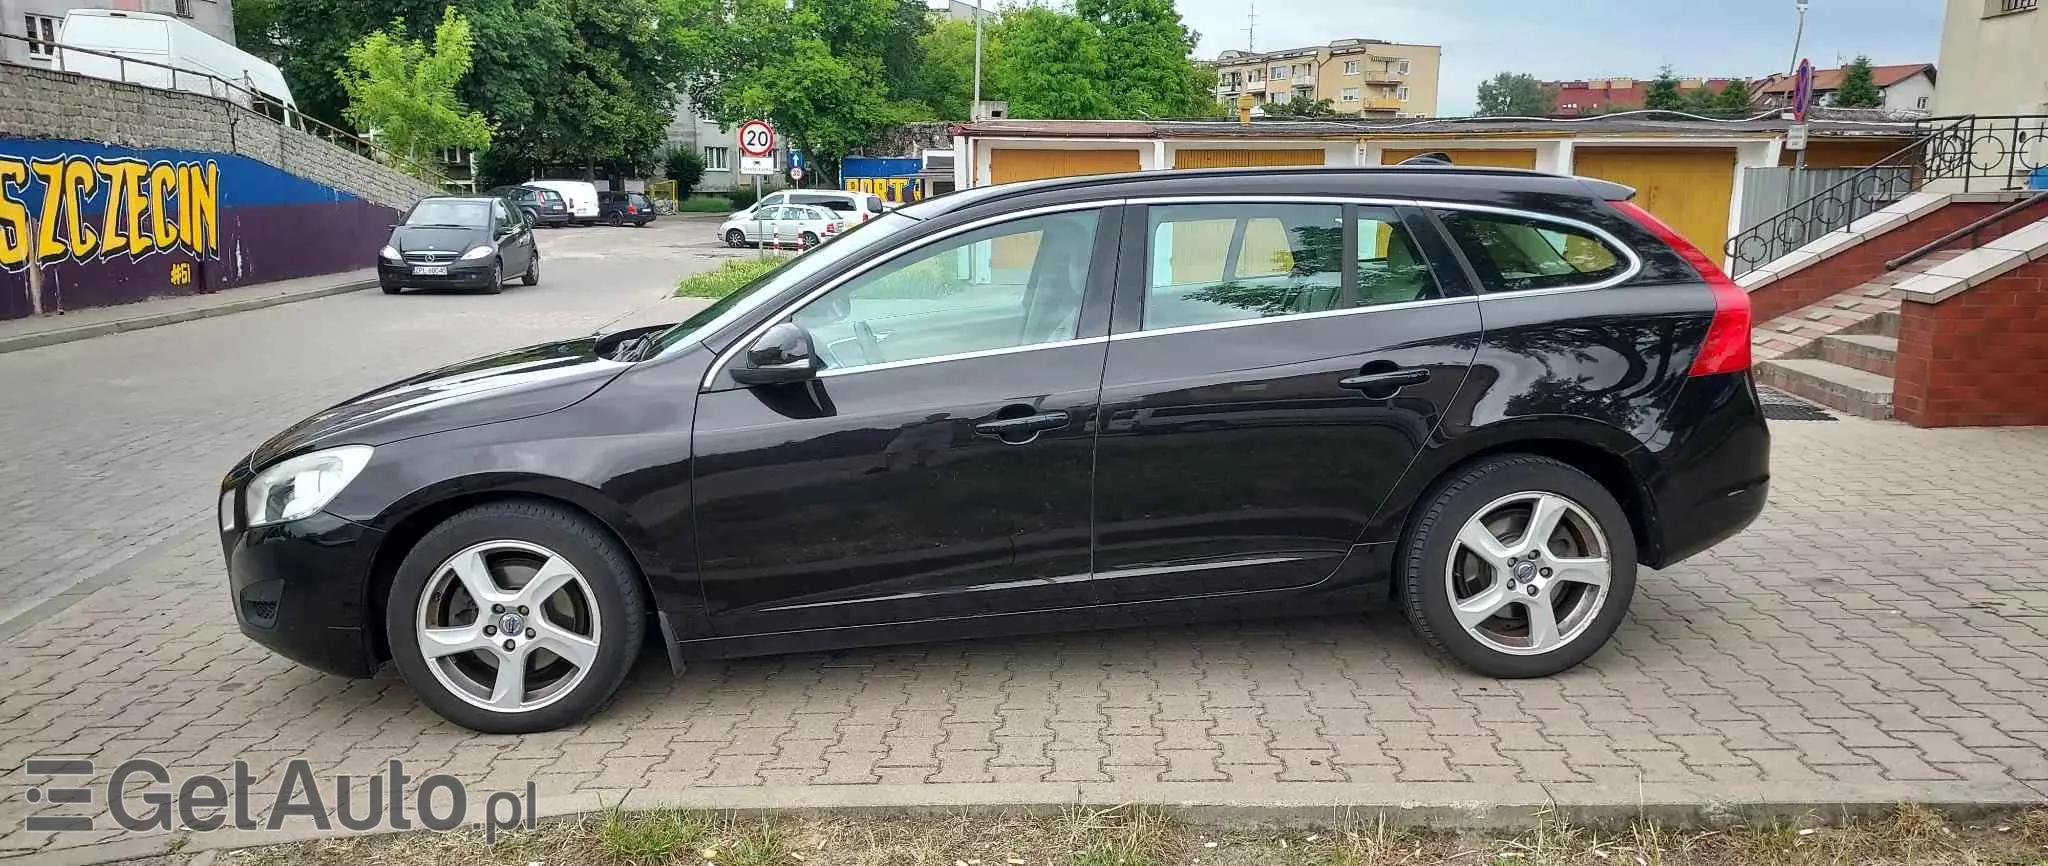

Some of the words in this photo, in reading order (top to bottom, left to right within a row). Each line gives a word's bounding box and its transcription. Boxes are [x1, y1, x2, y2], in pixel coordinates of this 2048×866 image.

[746, 130, 769, 147] 20
[0, 153, 220, 273] SZCZECIN
[170, 263, 192, 286] #61
